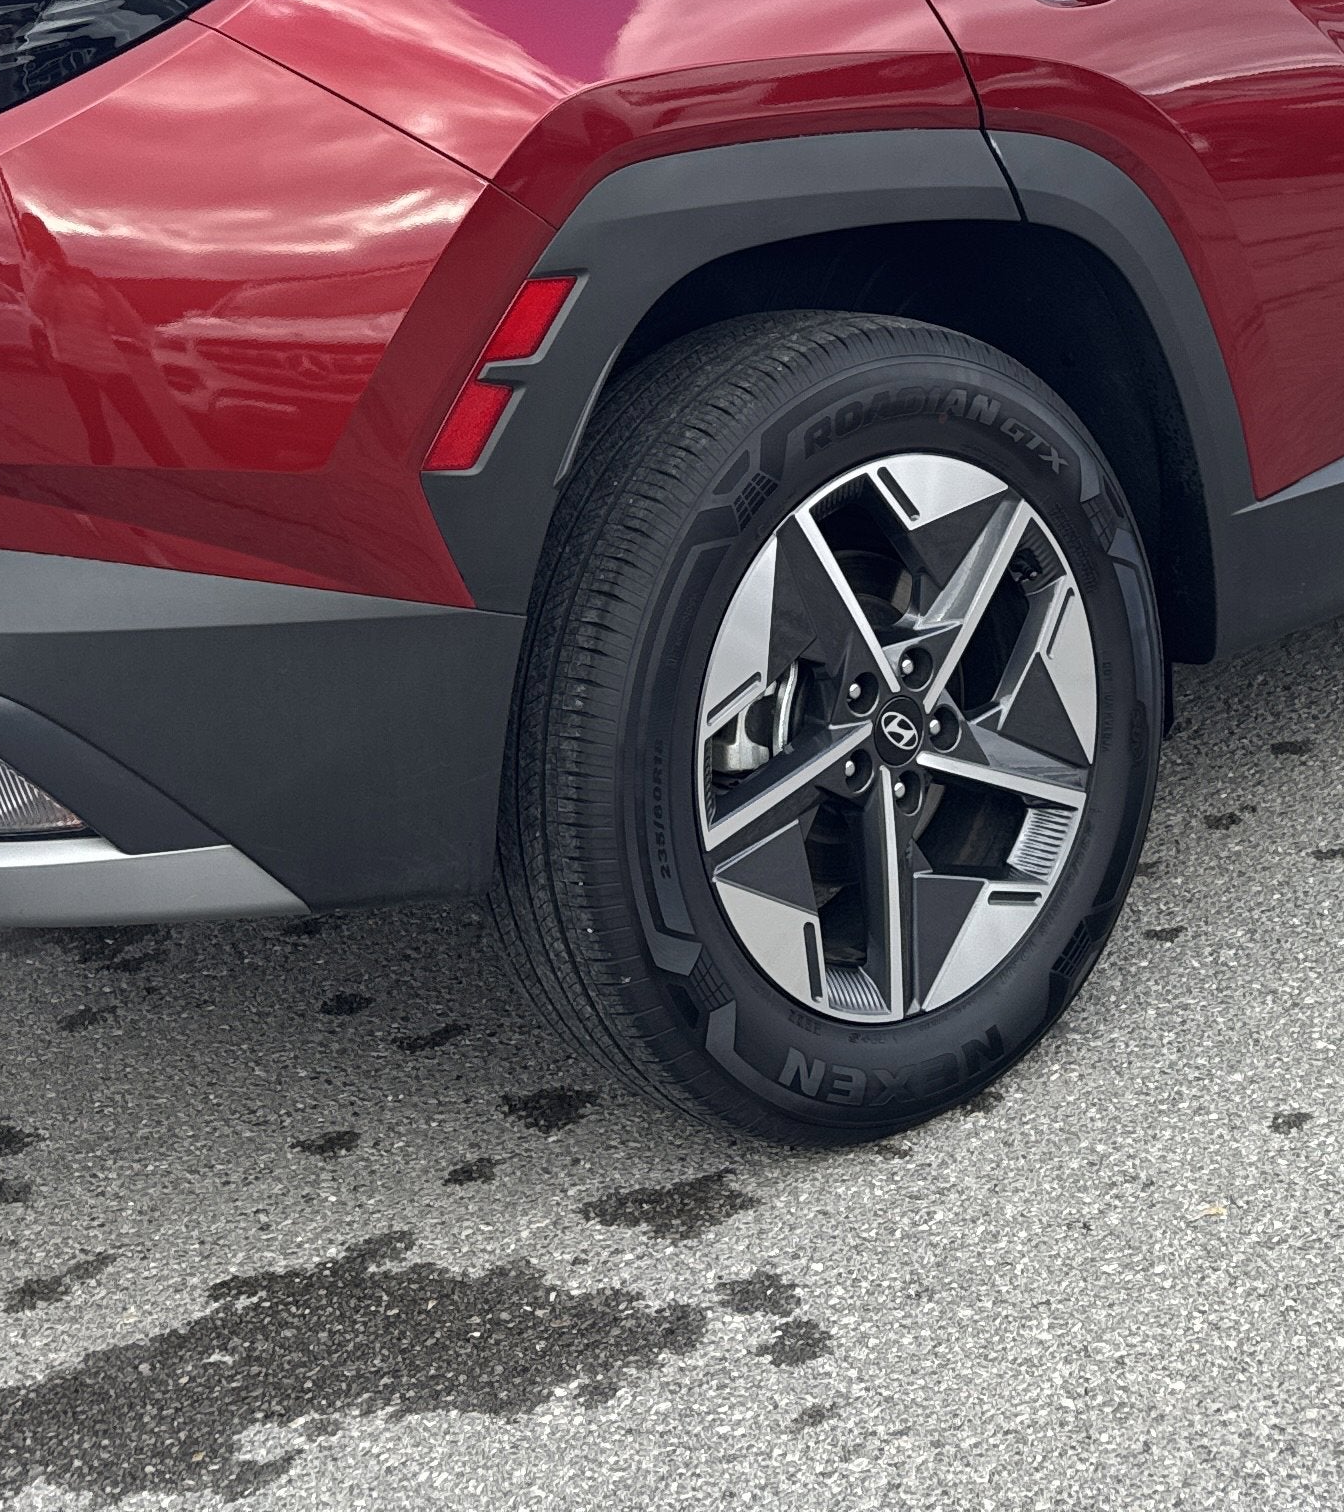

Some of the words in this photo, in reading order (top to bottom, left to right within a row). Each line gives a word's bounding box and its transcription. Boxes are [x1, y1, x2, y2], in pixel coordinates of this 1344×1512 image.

[804, 387, 1001, 452] ROADIAN
[1000, 417, 1069, 474] GTX
[778, 1024, 1005, 1106] NEXEN
